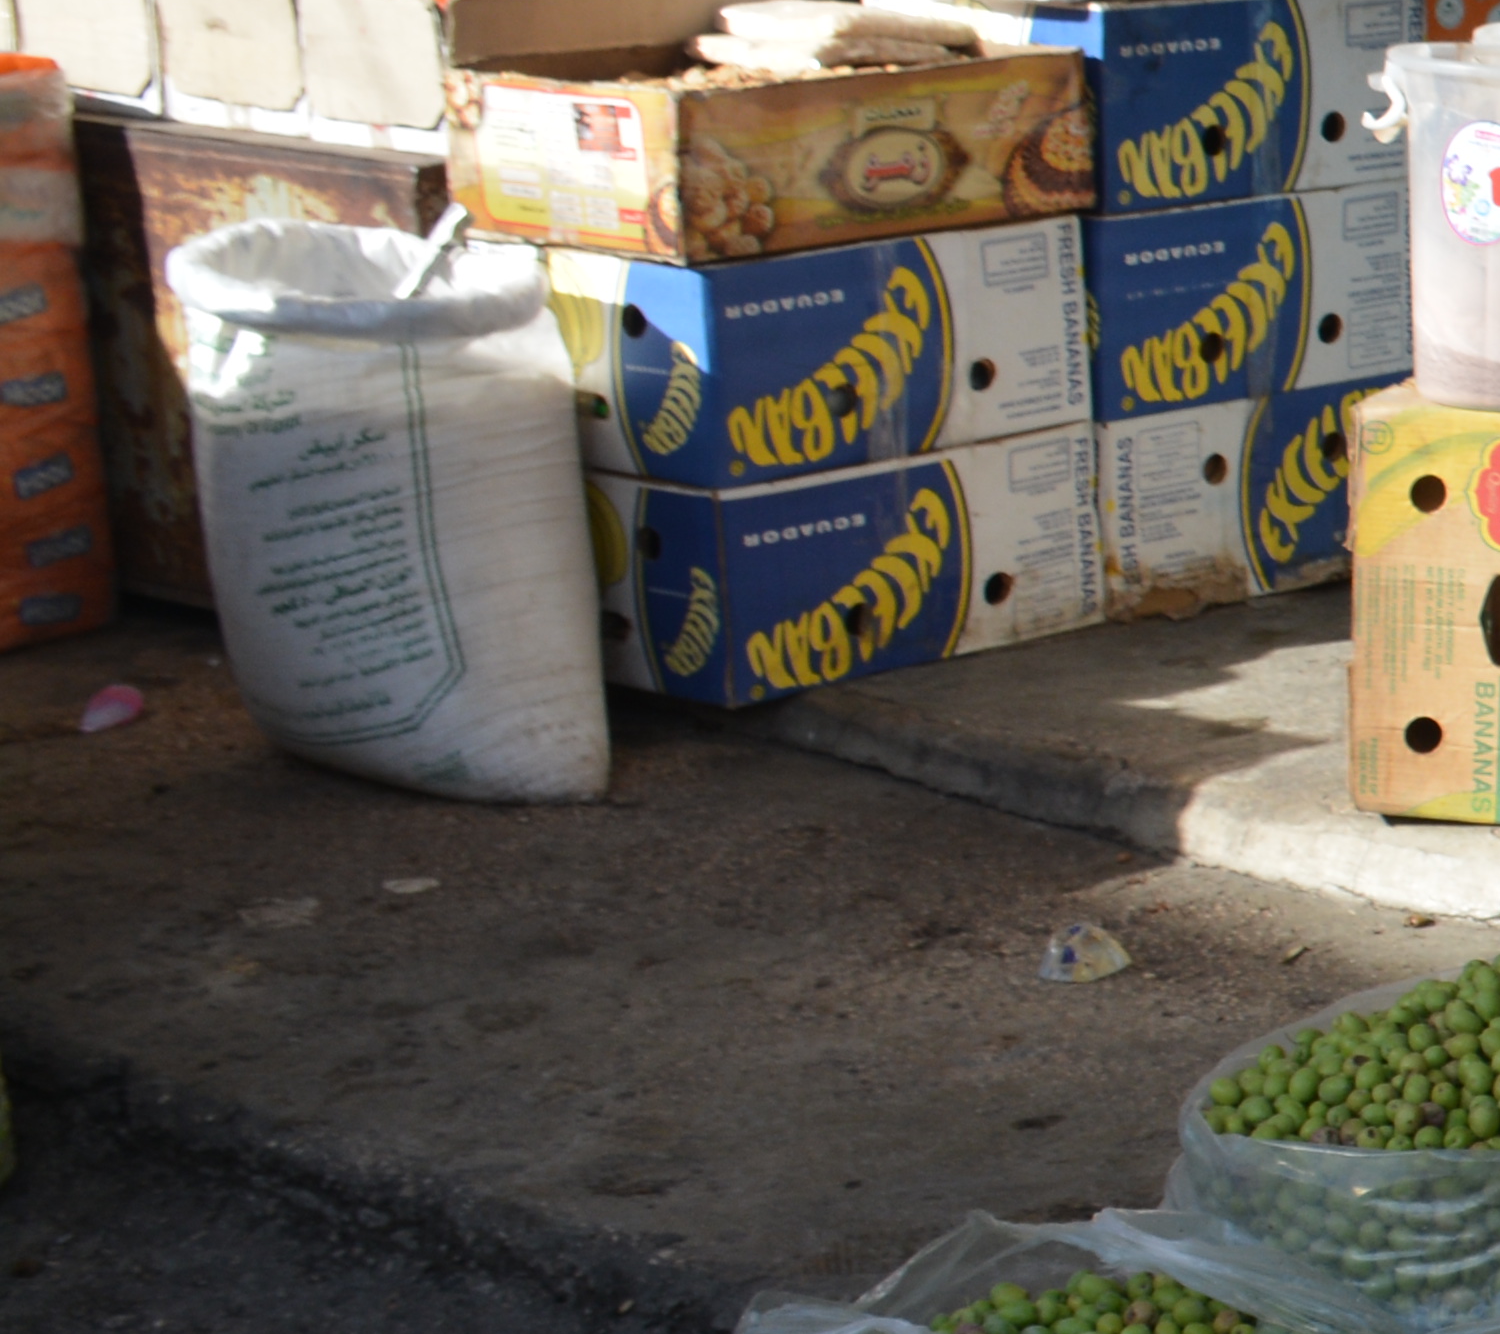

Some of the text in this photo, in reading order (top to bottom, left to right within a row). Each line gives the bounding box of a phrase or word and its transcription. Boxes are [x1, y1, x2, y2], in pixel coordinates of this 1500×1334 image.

[1119, 37, 1221, 58] ECUADOR
[1123, 240, 1226, 267] ECUADOR
[724, 288, 846, 321] ECUADOR
[1057, 222, 1085, 407] FRESH BANANAS
[1116, 436, 1137, 539] BANANAS
[742, 512, 866, 548] ECUADOR
[1073, 437, 1098, 614] FRESH BANANAS
[1470, 681, 1498, 815] BANANAS
